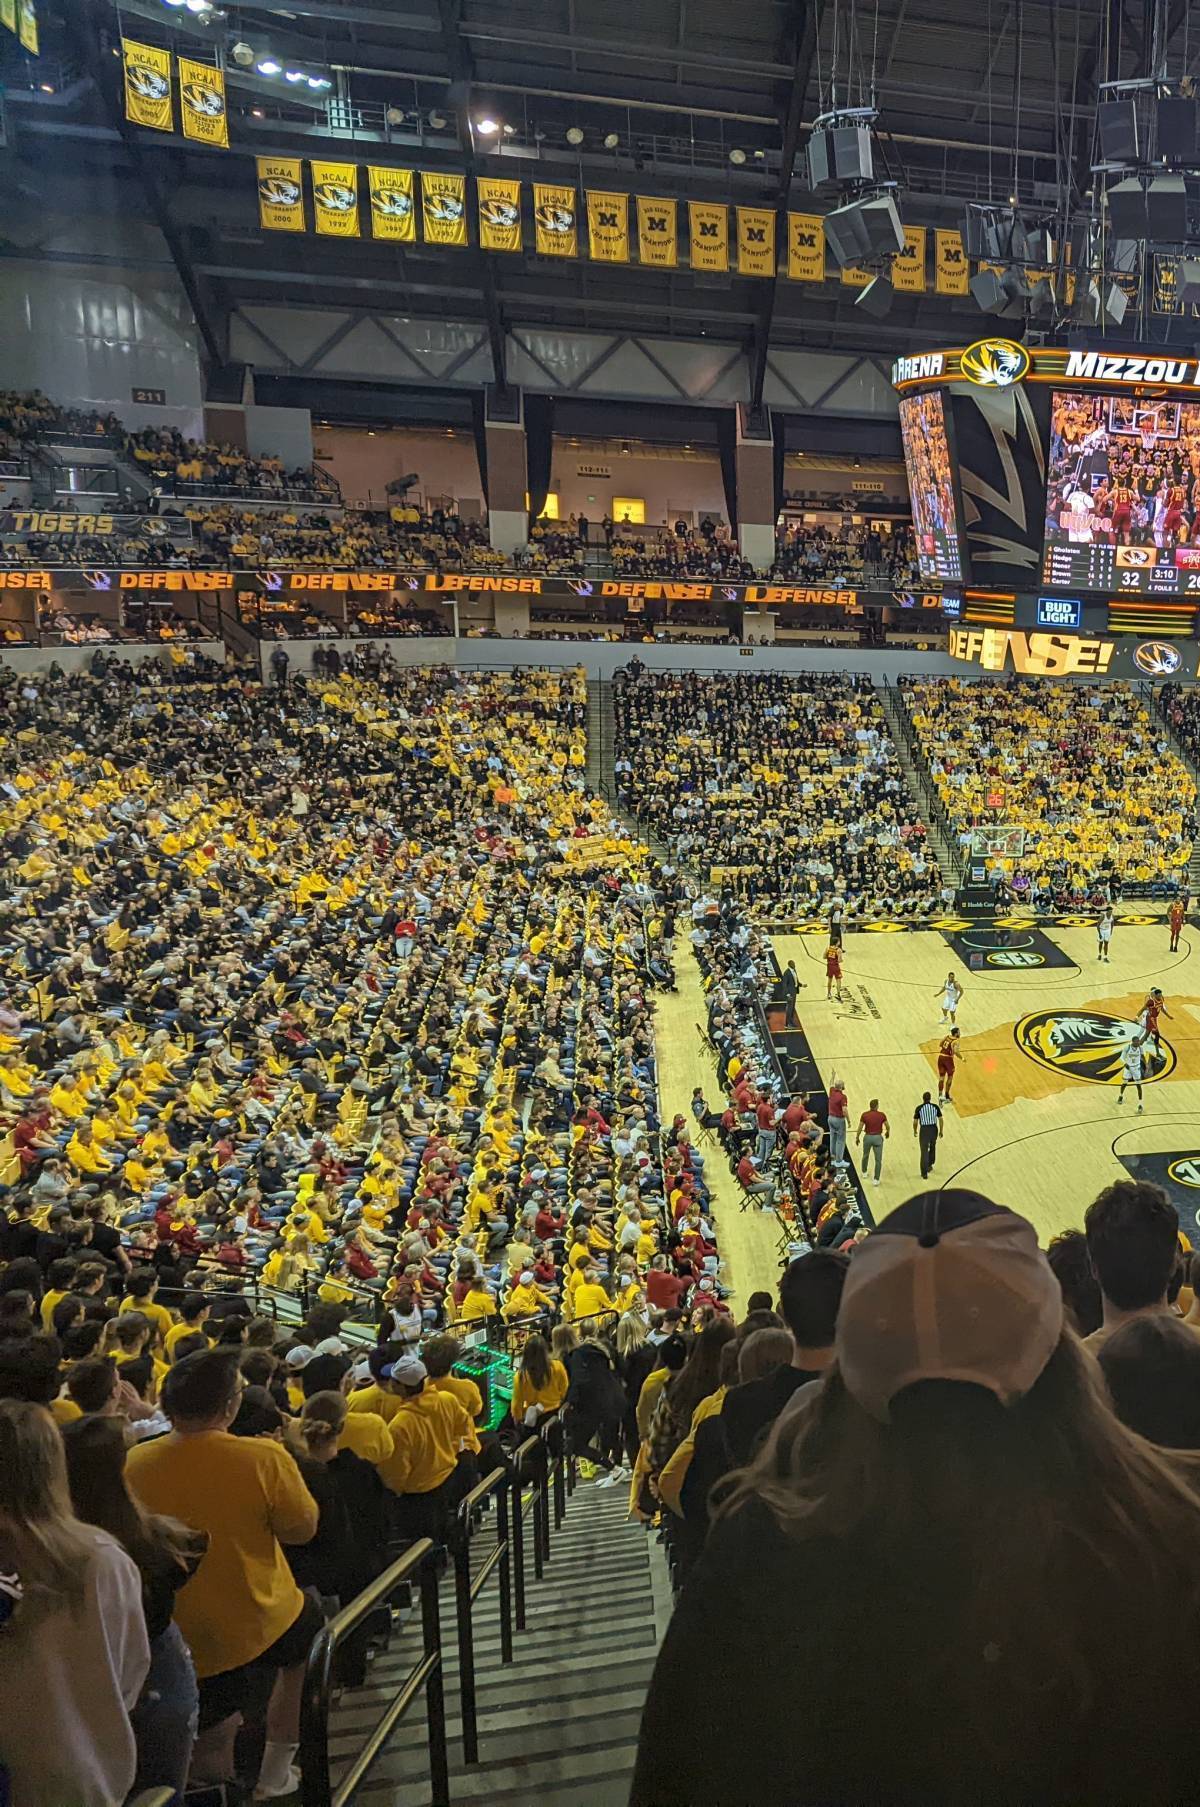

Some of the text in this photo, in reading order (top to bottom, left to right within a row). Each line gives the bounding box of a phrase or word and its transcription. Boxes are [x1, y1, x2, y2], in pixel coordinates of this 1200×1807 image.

[133, 53, 160, 68] NCAA
[189, 71, 215, 86] NCAA
[266, 167, 293, 178] NCAA
[321, 173, 348, 184] NCAA
[378, 178, 404, 188] NCAA
[431, 183, 457, 193] NCAA
[487, 189, 512, 199] NCAA
[543, 195, 567, 205] NCAA
[273, 215, 292, 223] 2000
[598, 212, 618, 227] M
[647, 217, 667, 232] M
[699, 222, 719, 237] M
[746, 227, 766, 242] M
[797, 232, 816, 247] M
[944, 248, 961, 263] M
[898, 354, 943, 378] ARENA
[1065, 351, 1189, 383] MIZZOU
[136, 391, 161, 402] 211
[11, 512, 114, 535] TIGERS
[1121, 571, 1140, 586] 32
[1155, 570, 1173, 579] 3:10
[425, 575, 541, 595] DEFENSE!
[745, 586, 857, 606] DEFENSE!
[1045, 602, 1072, 614] BUD
[1040, 611, 1077, 624] LIGHT
[992, 952, 1043, 965] SEC
